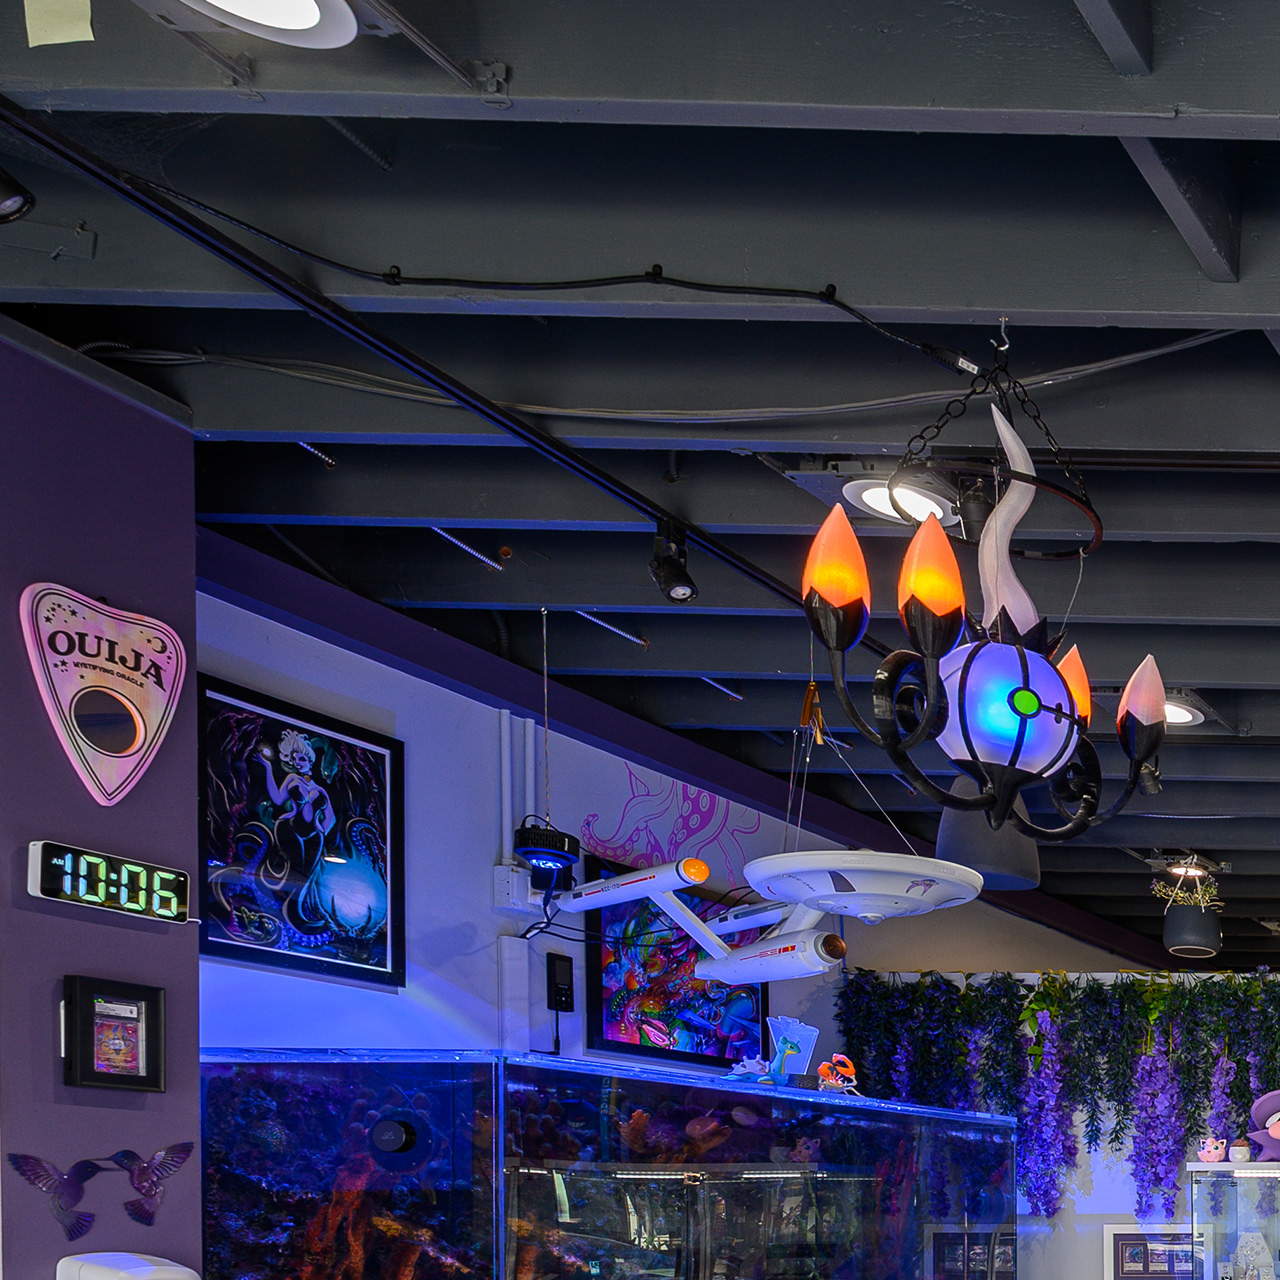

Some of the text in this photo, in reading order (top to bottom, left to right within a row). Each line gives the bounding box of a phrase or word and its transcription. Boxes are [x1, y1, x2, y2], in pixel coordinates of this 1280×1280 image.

[47, 630, 166, 693] OUIJA
[72, 661, 145, 688] MYSTIFYING ORACLE
[63, 853, 178, 917] 10:06
